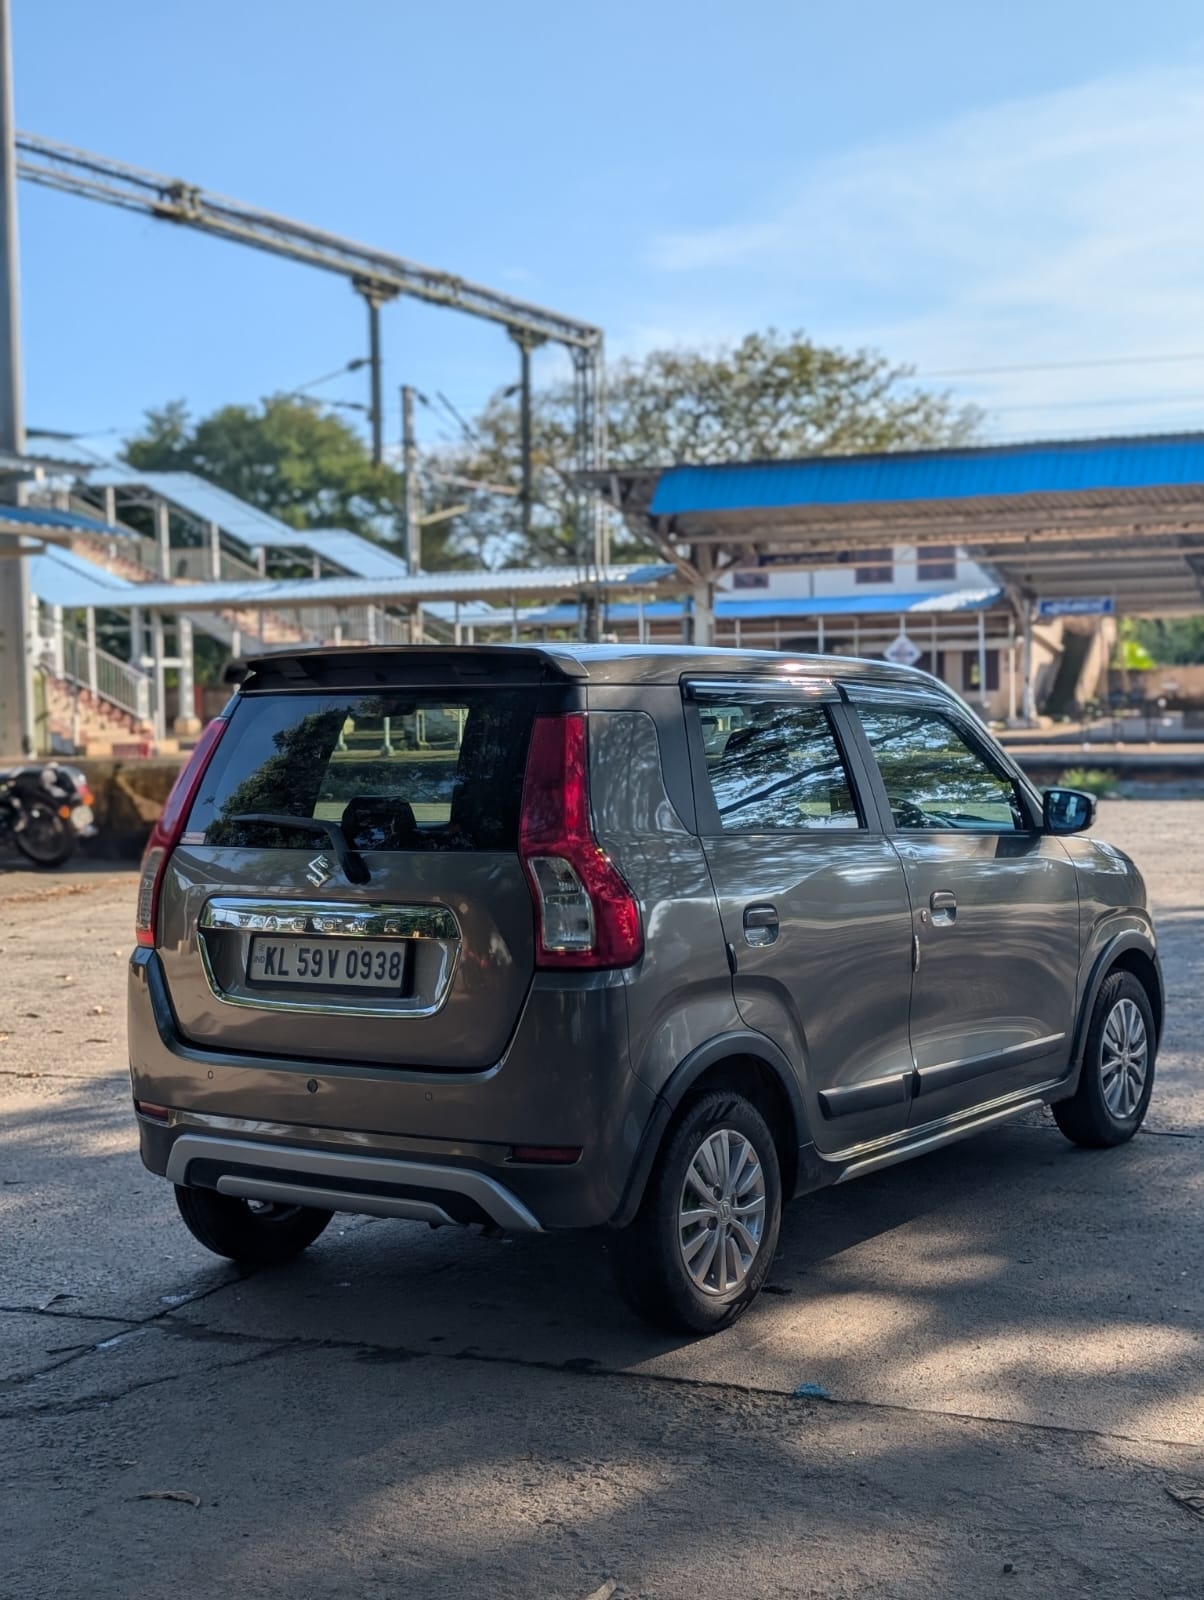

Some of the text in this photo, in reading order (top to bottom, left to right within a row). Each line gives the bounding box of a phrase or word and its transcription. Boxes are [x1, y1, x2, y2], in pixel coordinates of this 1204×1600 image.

[264, 946, 401, 981] KL 59 V 0938
